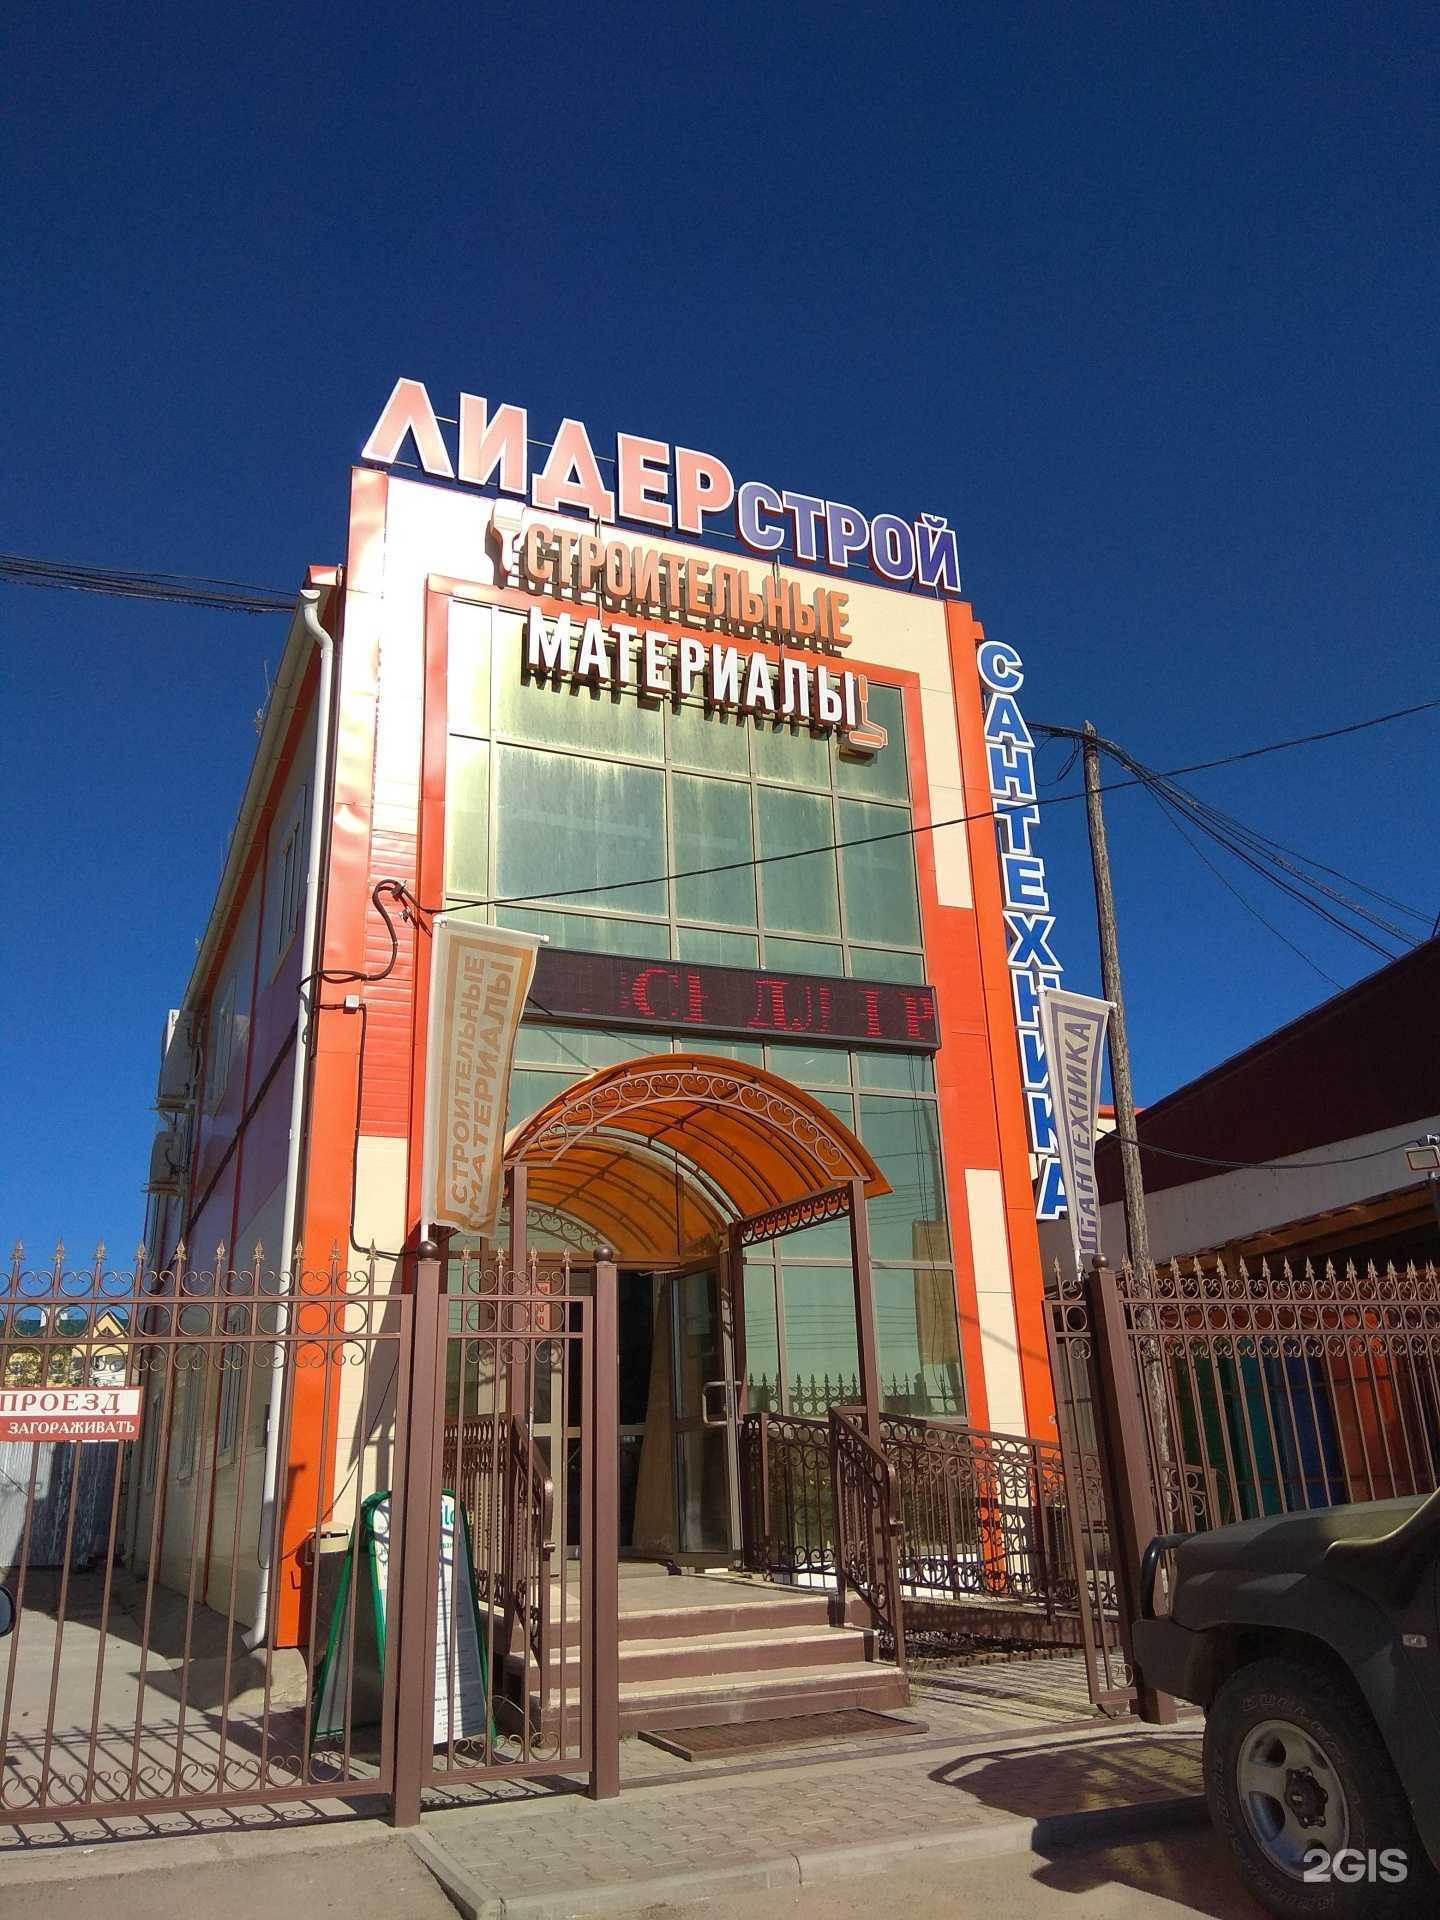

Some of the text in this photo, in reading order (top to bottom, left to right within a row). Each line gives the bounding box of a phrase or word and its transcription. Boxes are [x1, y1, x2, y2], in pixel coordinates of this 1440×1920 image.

[524, 522, 853, 648] СТРОИТЕЛЬНЫЕ
[526, 606, 858, 727] МАТЕРИАЛЫ
[451, 954, 486, 1203] СТРОИТЕЛЬНЫЕ
[468, 959, 515, 1213] МАТЕРИАЛЫ
[0, 1393, 121, 1415] ПРОЕЗД
[7, 1420, 136, 1435] ЗАГОРАЖИВАТЬ
